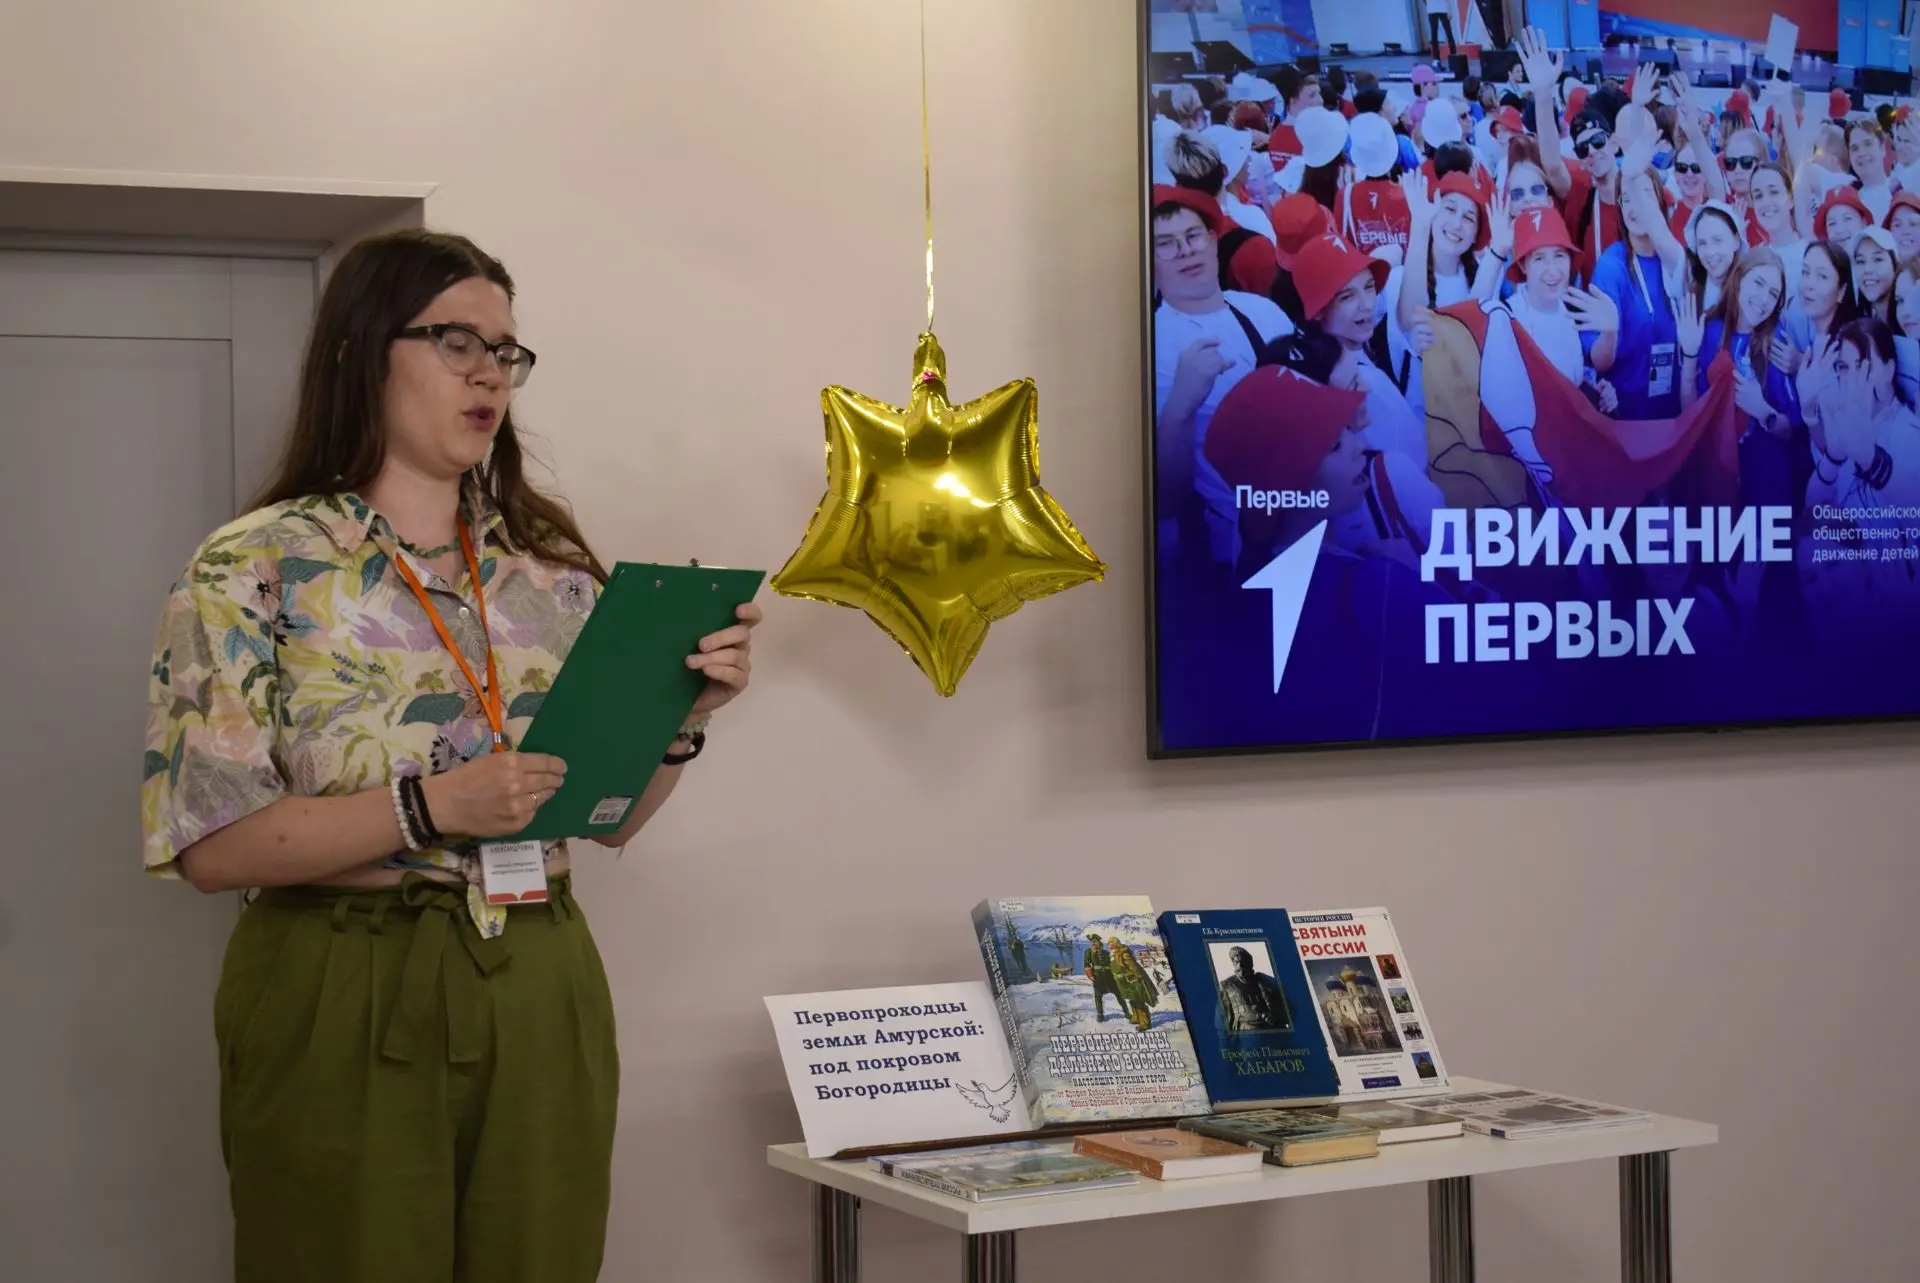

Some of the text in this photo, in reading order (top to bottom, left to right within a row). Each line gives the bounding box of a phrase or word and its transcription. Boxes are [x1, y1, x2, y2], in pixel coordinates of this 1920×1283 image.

[1236, 485, 1330, 514] Первые
[1420, 505, 1793, 582] ДВИЖЕНИЕ
[1812, 526, 1920, 542] общественно-го
[1812, 545, 1919, 564] движение детей
[1424, 597, 1696, 664] ПЕРВЫХ
[1294, 913, 1352, 923] ИСТОРИЯ РОССИИ
[1291, 924, 1367, 940] СВЯТЫНИ
[1301, 941, 1368, 957] РОССИИ
[793, 1001, 968, 1027] Первопроходцы
[802, 1020, 985, 1050] земли Амурской:
[1049, 1031, 1171, 1053] ПЕРВОПРОХОДЦЫ
[809, 1051, 962, 1075] под покровом
[1048, 1051, 1186, 1077] ДАЛЬНЕГО ВОСТОКА
[1221, 1048, 1260, 1061] Ерофей
[1235, 1059, 1305, 1075] ХАБАРОВ
[815, 1077, 952, 1100] Богородицы
[1072, 1074, 1167, 1087] НАСТОЯЩИЕ РУССКИЕ ГЕРОИ
